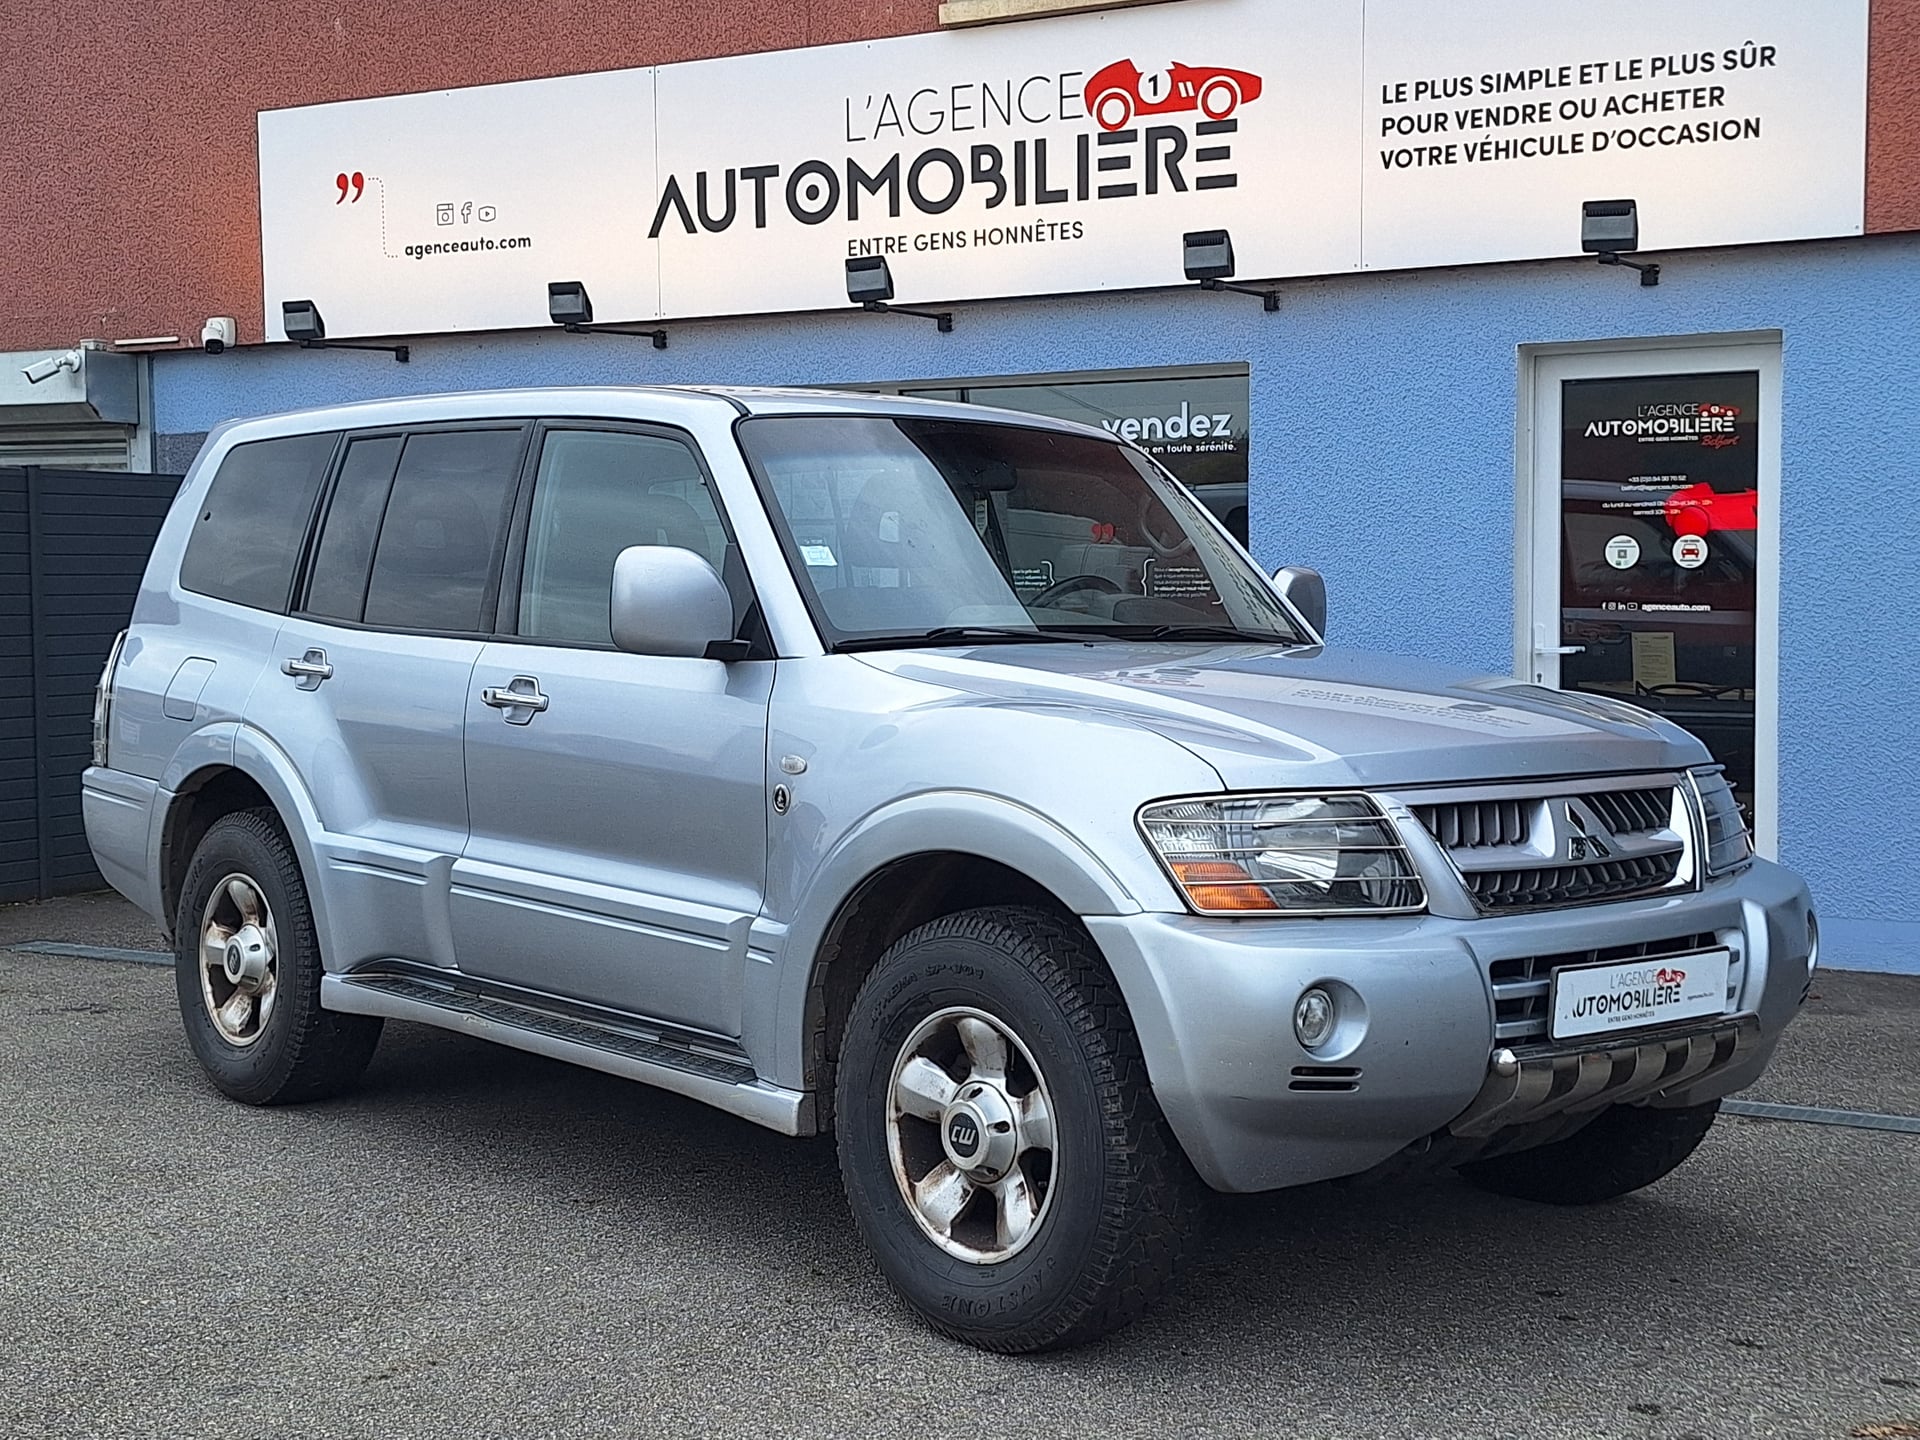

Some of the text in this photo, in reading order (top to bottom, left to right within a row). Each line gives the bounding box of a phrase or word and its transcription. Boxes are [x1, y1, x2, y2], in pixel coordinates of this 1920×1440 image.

[1382, 40, 1777, 104] LE PLUS SIMPLE ET LE PLUS SÛR
[1381, 86, 1726, 137] POUR VENDRE OU ACHETER
[1381, 117, 1761, 169] VOTRE VÉHICULE D'OCCASION
[405, 236, 532, 259] agenceauto.com
[848, 218, 1084, 257] ENTRE GENS HONNÊTES
[1102, 400, 1232, 440] vendez
[1152, 446, 1165, 454] en
[1167, 444, 1193, 453] toute
[1641, 603, 1711, 613] agenceauto.com
